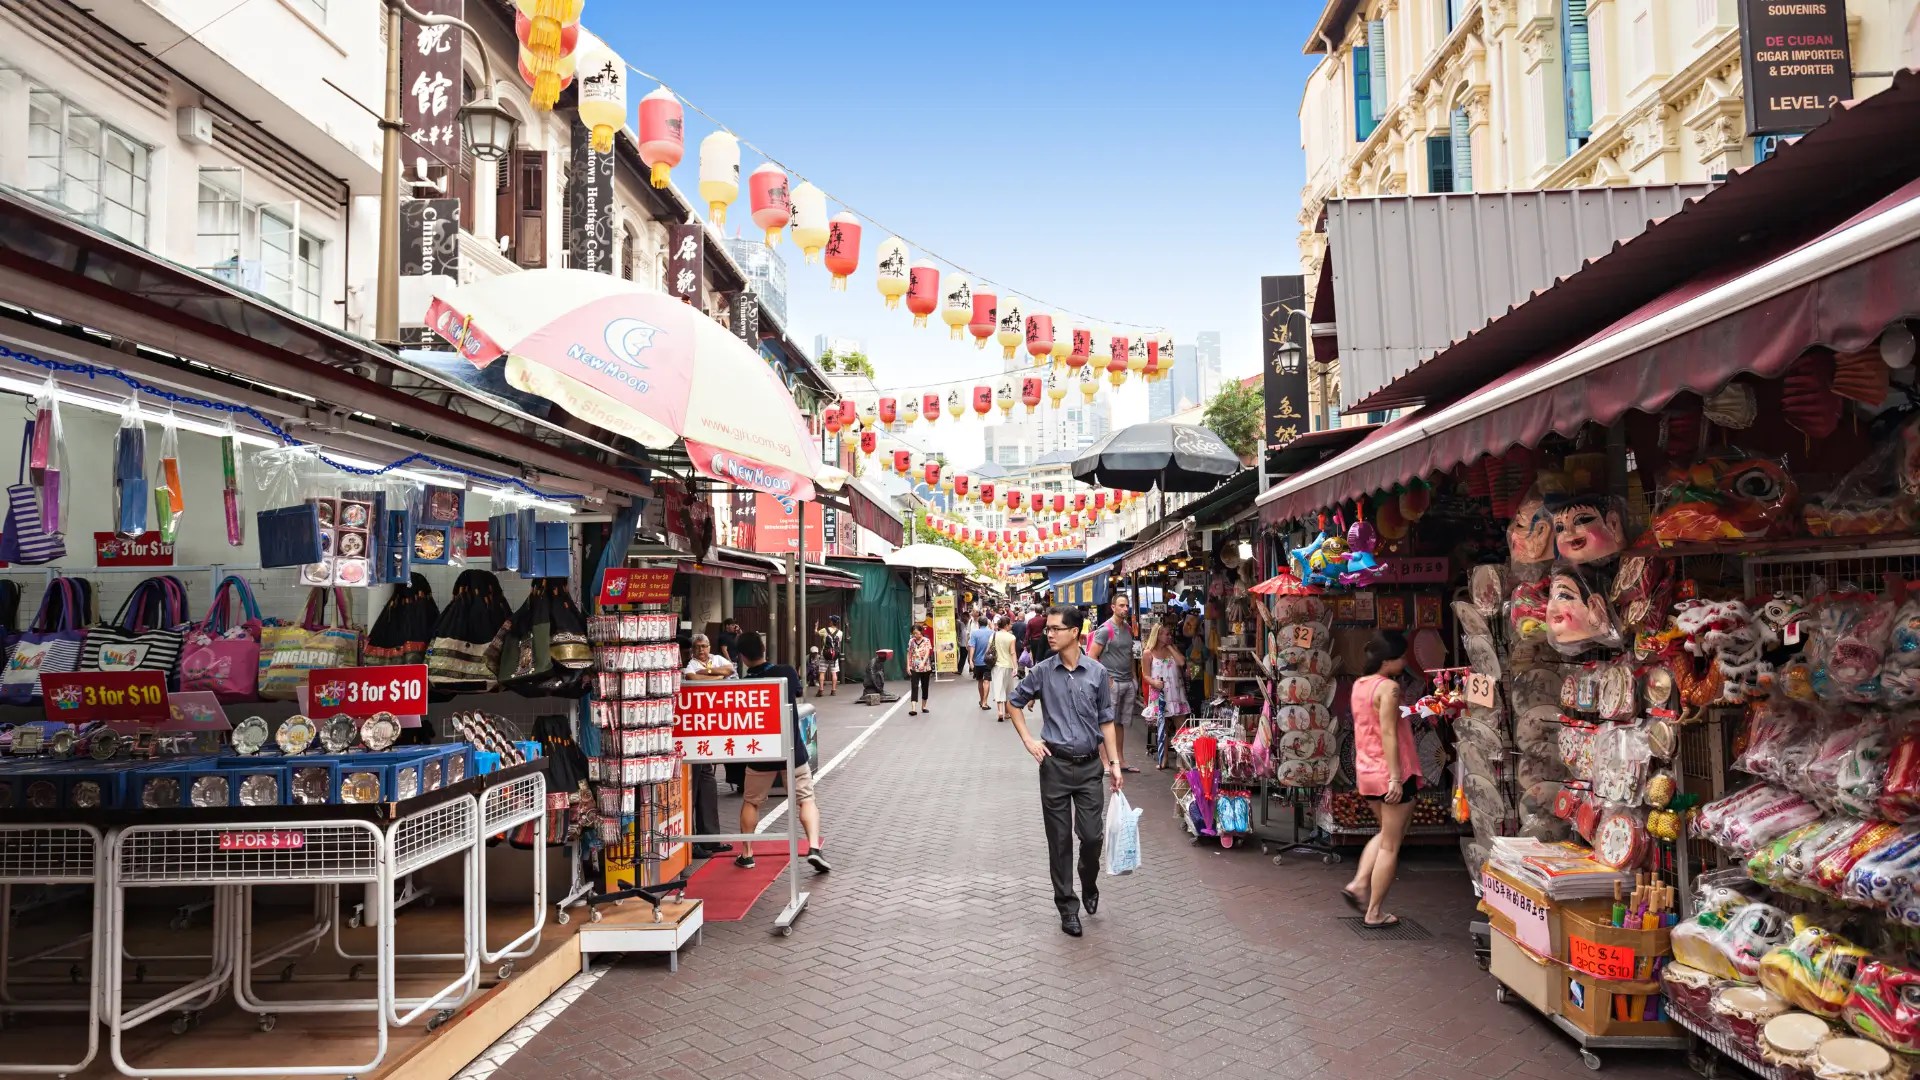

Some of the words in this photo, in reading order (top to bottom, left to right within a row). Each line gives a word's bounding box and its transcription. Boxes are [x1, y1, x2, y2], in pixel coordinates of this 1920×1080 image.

[1768, 4, 1827, 16] SOUVENIRS
[1765, 36, 1785, 47] DE
[1787, 35, 1833, 46] CUBAN
[1756, 51, 1789, 62] CIGAR
[1791, 49, 1845, 61] IMPORTER
[1769, 66, 1778, 77] &
[1780, 64, 1834, 76] EXPORTER
[1770, 96, 1825, 111] LEVEL
[585, 186, 598, 236] Heritage
[474, 531, 482, 546] 3
[121, 542, 129, 556] 3
[131, 541, 148, 556] for
[1293, 626, 1309, 641] $2
[347, 681, 359, 703] 3
[361, 681, 387, 702] for
[389, 678, 421, 703] $10
[1472, 677, 1490, 697] $3
[84, 686, 96, 706] 3
[100, 685, 126, 705] for
[127, 684, 161, 706] $10
[674, 689, 771, 710] UTY-FREE
[222, 834, 231, 847] 3
[235, 833, 267, 847] FOR
[284, 833, 301, 846] 10
